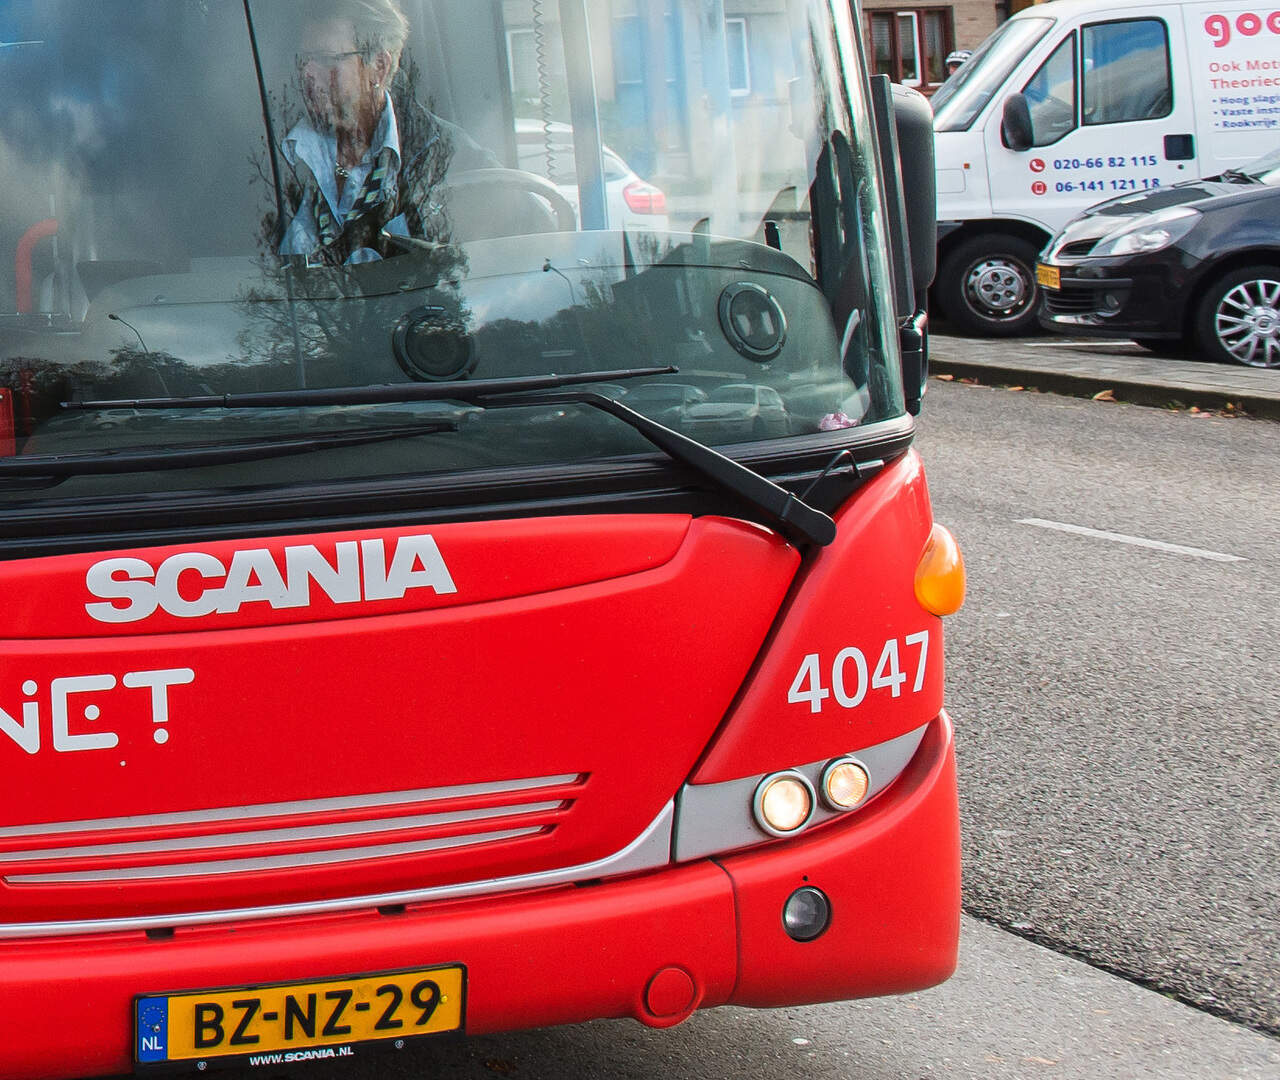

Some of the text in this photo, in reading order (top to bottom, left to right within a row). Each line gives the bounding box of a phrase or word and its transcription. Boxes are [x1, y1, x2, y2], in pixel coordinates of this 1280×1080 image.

[1209, 61, 1241, 72] Ook
[1054, 155, 1158, 170] 020-66 82 115
[1055, 180, 1104, 192] 06-141
[1110, 179, 1136, 190] 121
[84, 534, 458, 623] SCANIA
[787, 630, 929, 713] 4047
[141, 979, 441, 1051] NL BZ-NZ-29
[249, 1045, 354, 1066] WWW.SCANIA.NL
